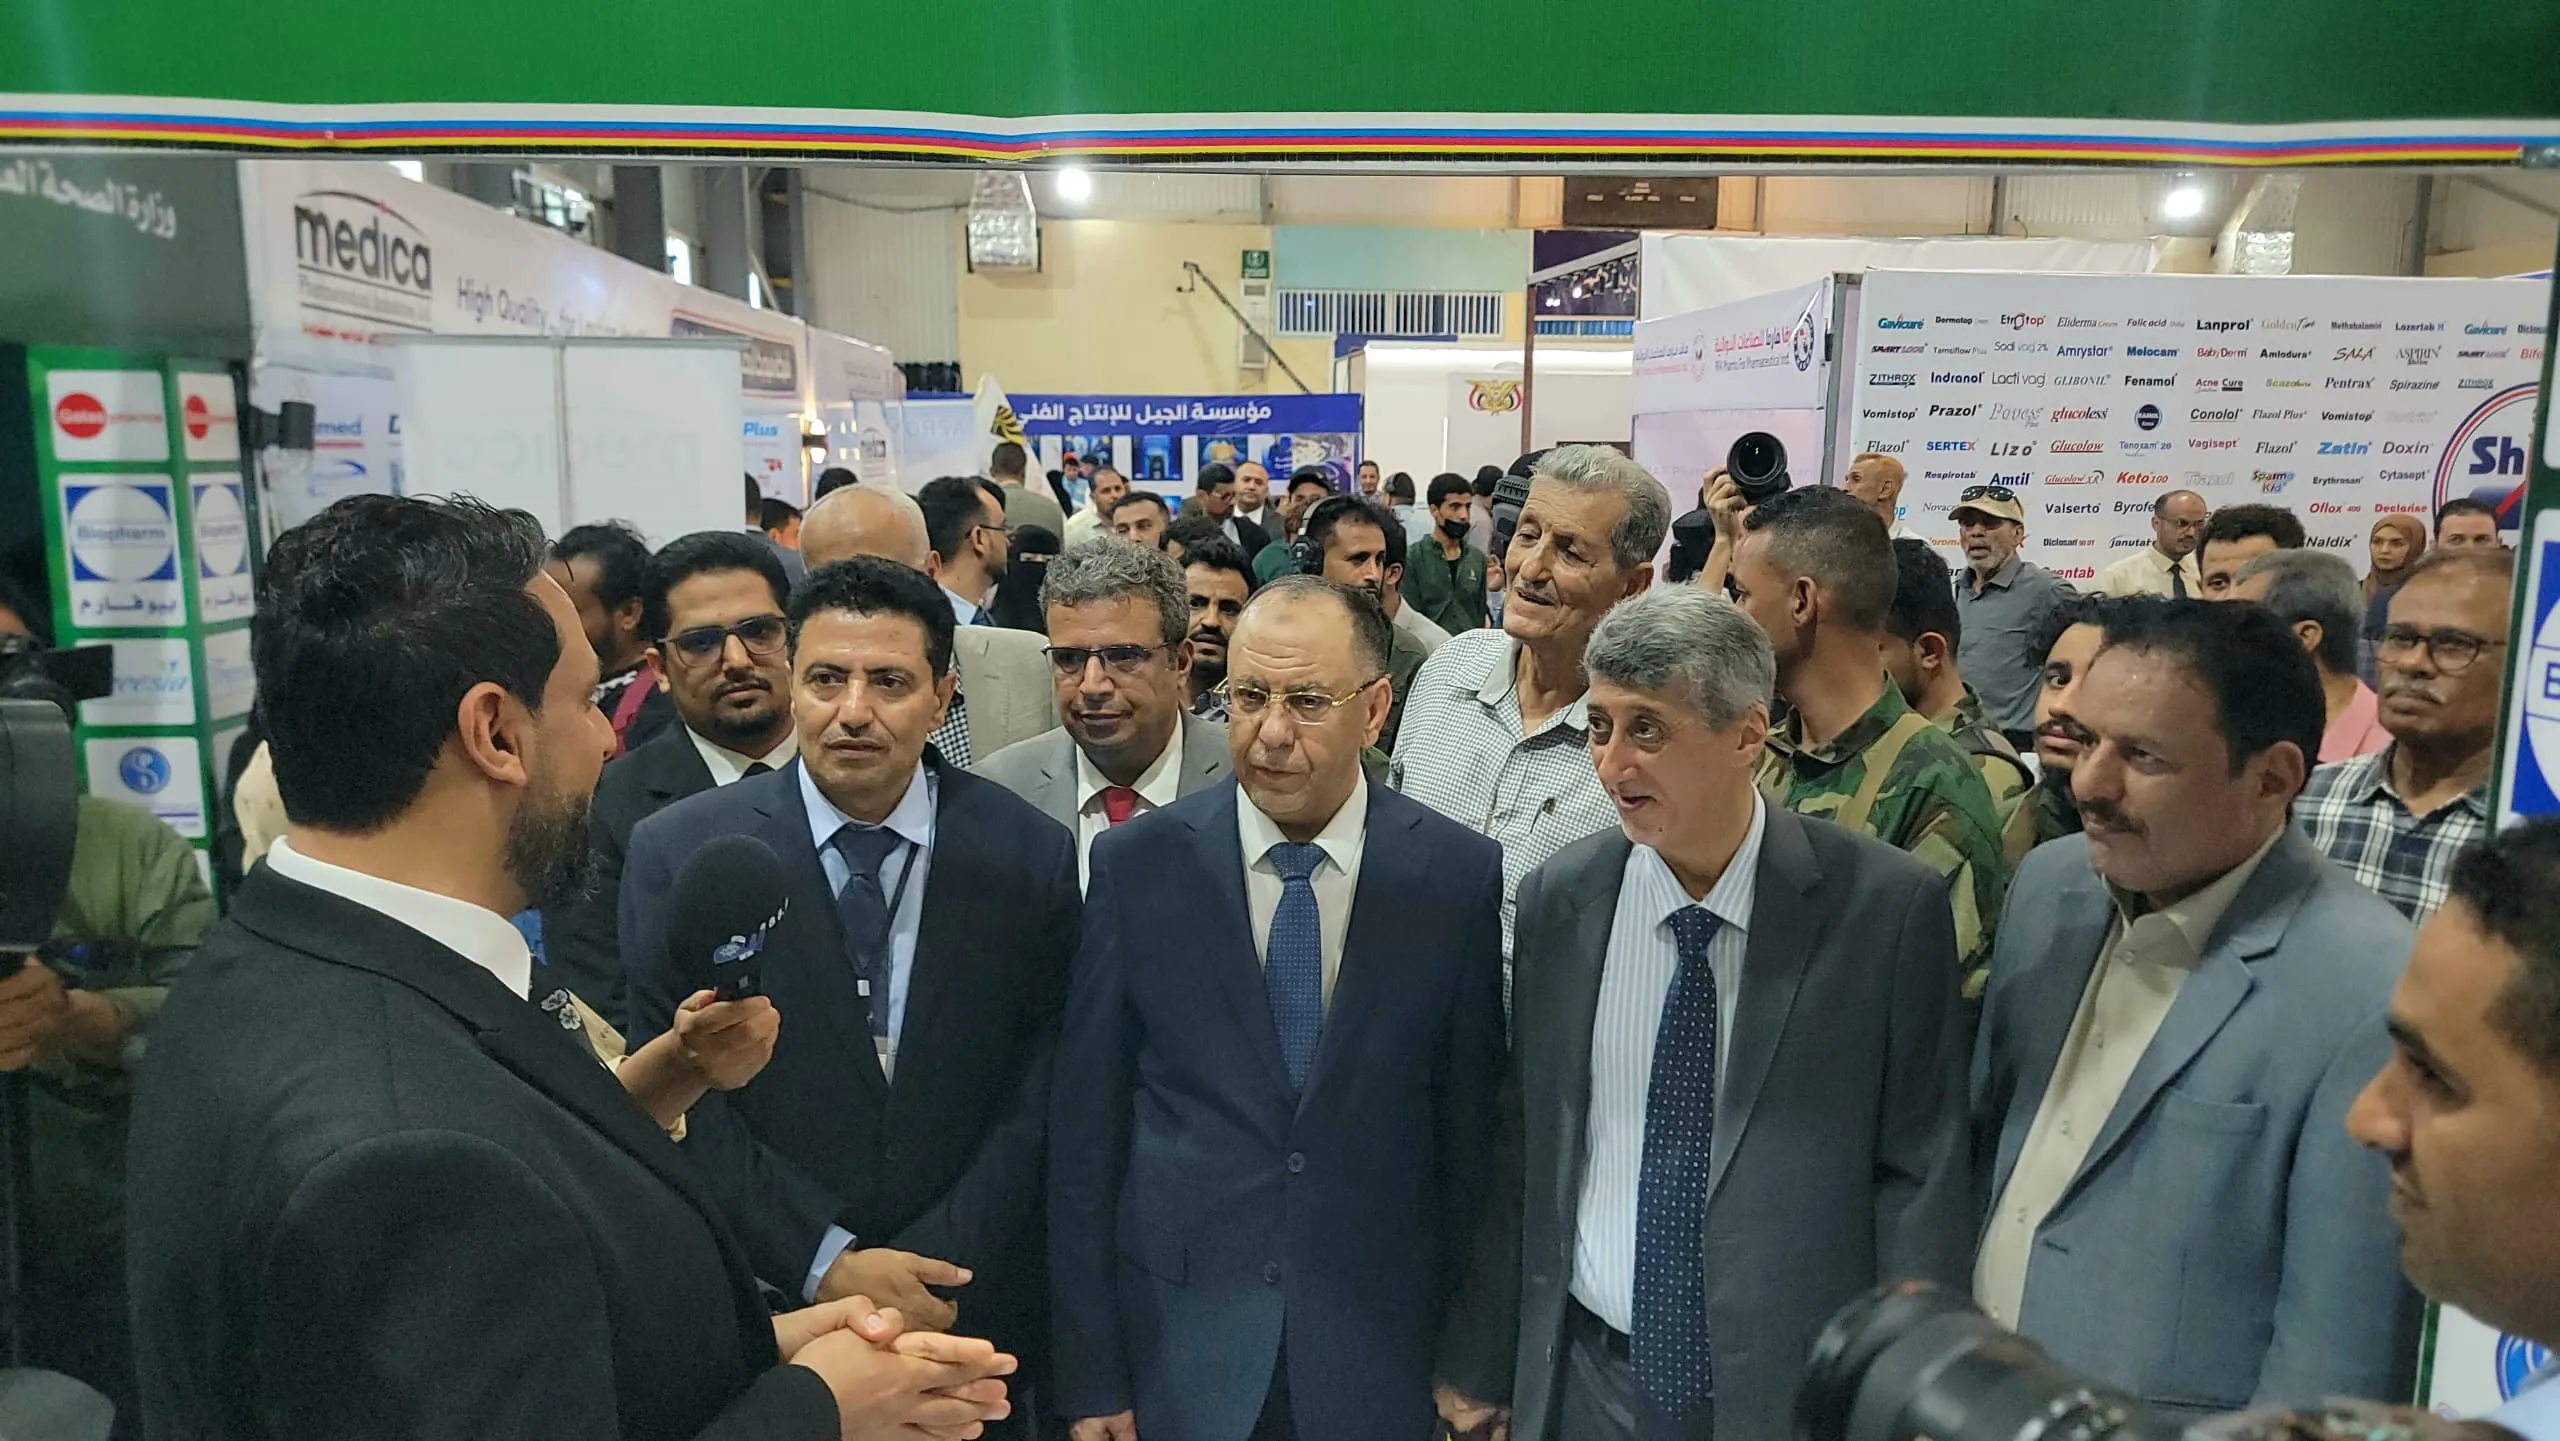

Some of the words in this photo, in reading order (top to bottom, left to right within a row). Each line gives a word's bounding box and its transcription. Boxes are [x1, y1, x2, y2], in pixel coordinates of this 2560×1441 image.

[294, 204, 432, 291] medica
[457, 275, 494, 323] High
[2197, 319, 2250, 333] Lanprol
[2057, 346, 2108, 359] Amrystar
[2260, 348, 2307, 358] Amlodura
[1931, 372, 1982, 383] Indranol
[1992, 372, 2019, 384] Lacti
[2124, 376, 2175, 386] Fenamol
[2196, 378, 2218, 387] Acne
[2222, 379, 2243, 388] Cure
[1017, 401, 1064, 428] الفني
[1067, 403, 1131, 427] للإنتاج
[1135, 403, 1188, 425] الجيل
[1191, 400, 1271, 424] مؤسسة
[1863, 409, 1915, 420] Vomistop
[1929, 405, 1976, 416] Prazol
[2190, 408, 2239, 419] Conolol
[2252, 409, 2281, 419] Flazol
[2321, 411, 2372, 422] Vomistop
[744, 421, 778, 437] Plus
[1867, 441, 1905, 452] Flazol
[1926, 442, 1975, 450] SERTEX
[1990, 442, 2032, 456] Lizo
[2050, 440, 2103, 452] Glucolow
[2188, 438, 2236, 450] Vagisept
[2256, 441, 2293, 453] Flazol
[2317, 442, 2368, 454] Zatin
[2382, 441, 2429, 454] Doxin
[1925, 471, 1976, 480] Respirotab
[1990, 472, 2030, 485] Amtil
[2117, 472, 2149, 484] Keto
[2046, 503, 2099, 513] Valserto
[2306, 536, 2352, 548] Naldix
